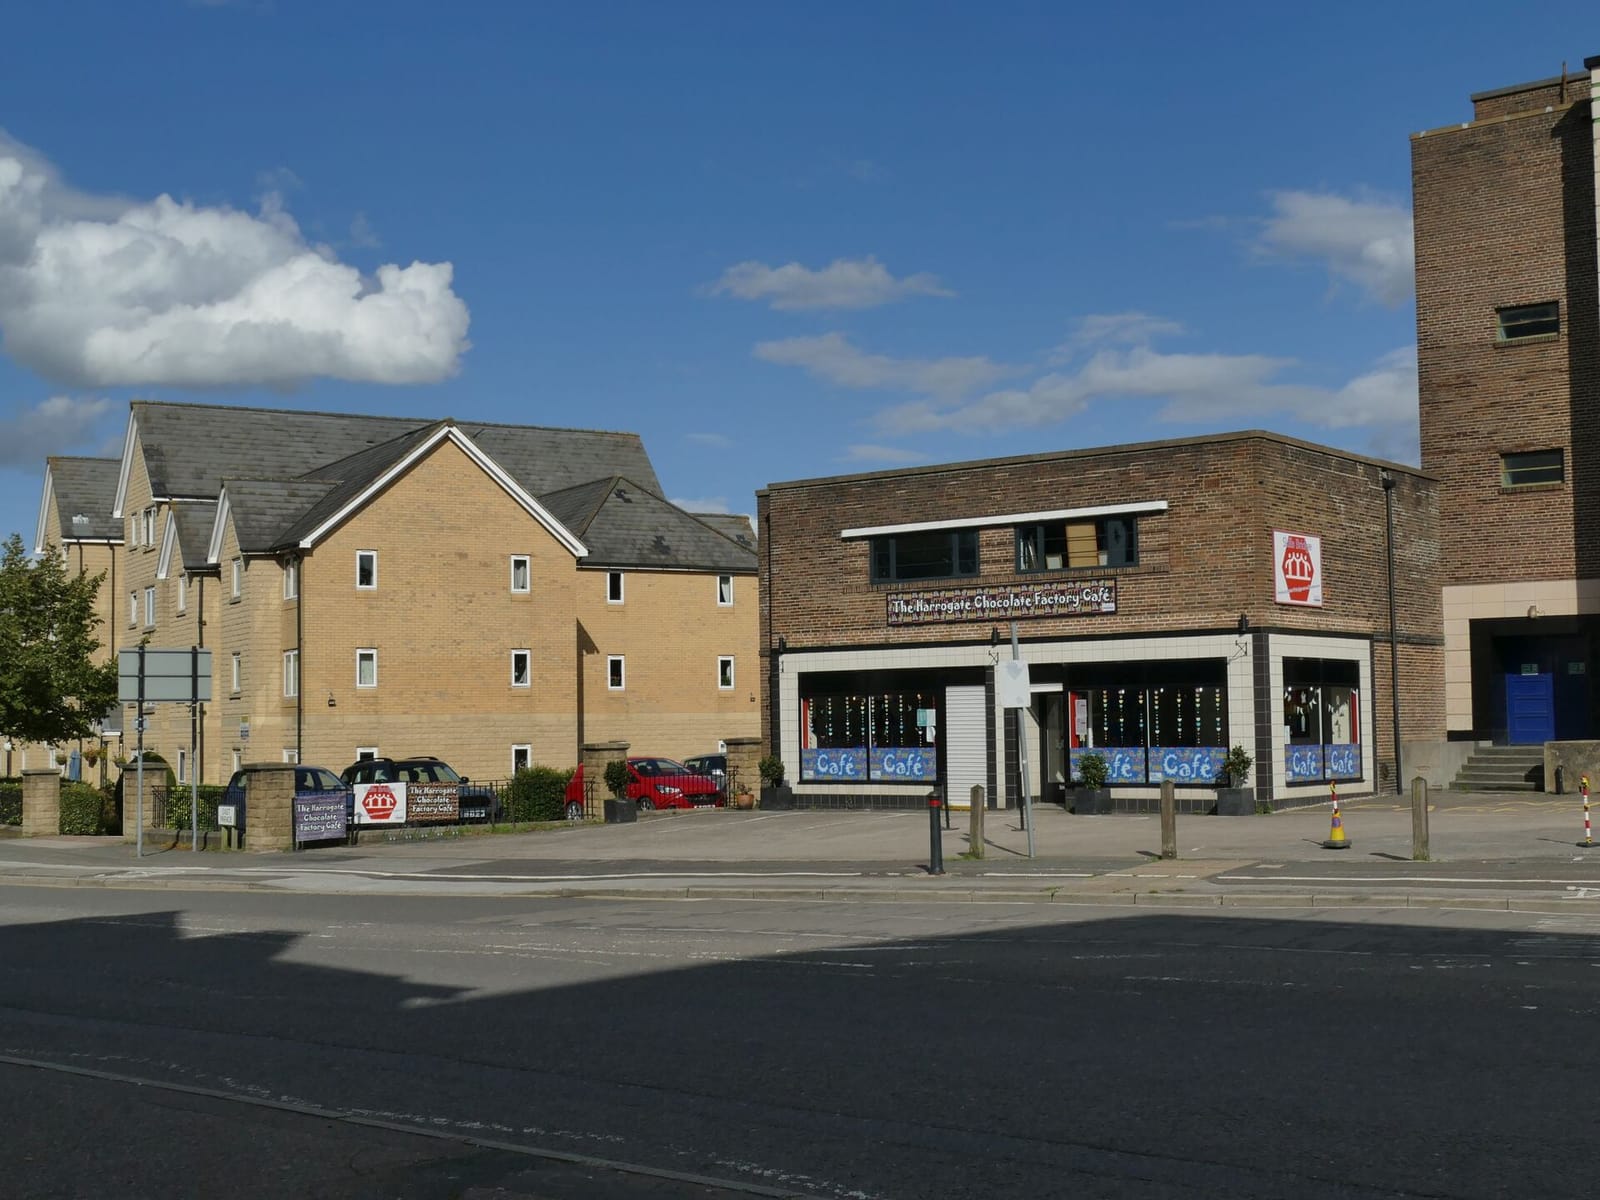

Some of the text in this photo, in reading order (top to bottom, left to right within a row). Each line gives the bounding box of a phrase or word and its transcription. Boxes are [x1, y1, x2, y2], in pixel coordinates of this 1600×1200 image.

[893, 588, 1110, 614] The Harrogate Chocolate Factory Café
[817, 753, 855, 775] Café
[883, 753, 923, 775] Café
[1104, 753, 1133, 778] afé
[1163, 753, 1212, 778] Café
[1293, 752, 1317, 776] Café
[1331, 751, 1353, 774] Café
[410, 786, 457, 796] The Harrogate
[416, 795, 450, 804] Chocolate
[297, 803, 345, 813] The Harrogate
[303, 812, 338, 822] Chocolate
[412, 804, 453, 814] Factory Café
[300, 820, 342, 832] Factory Café
